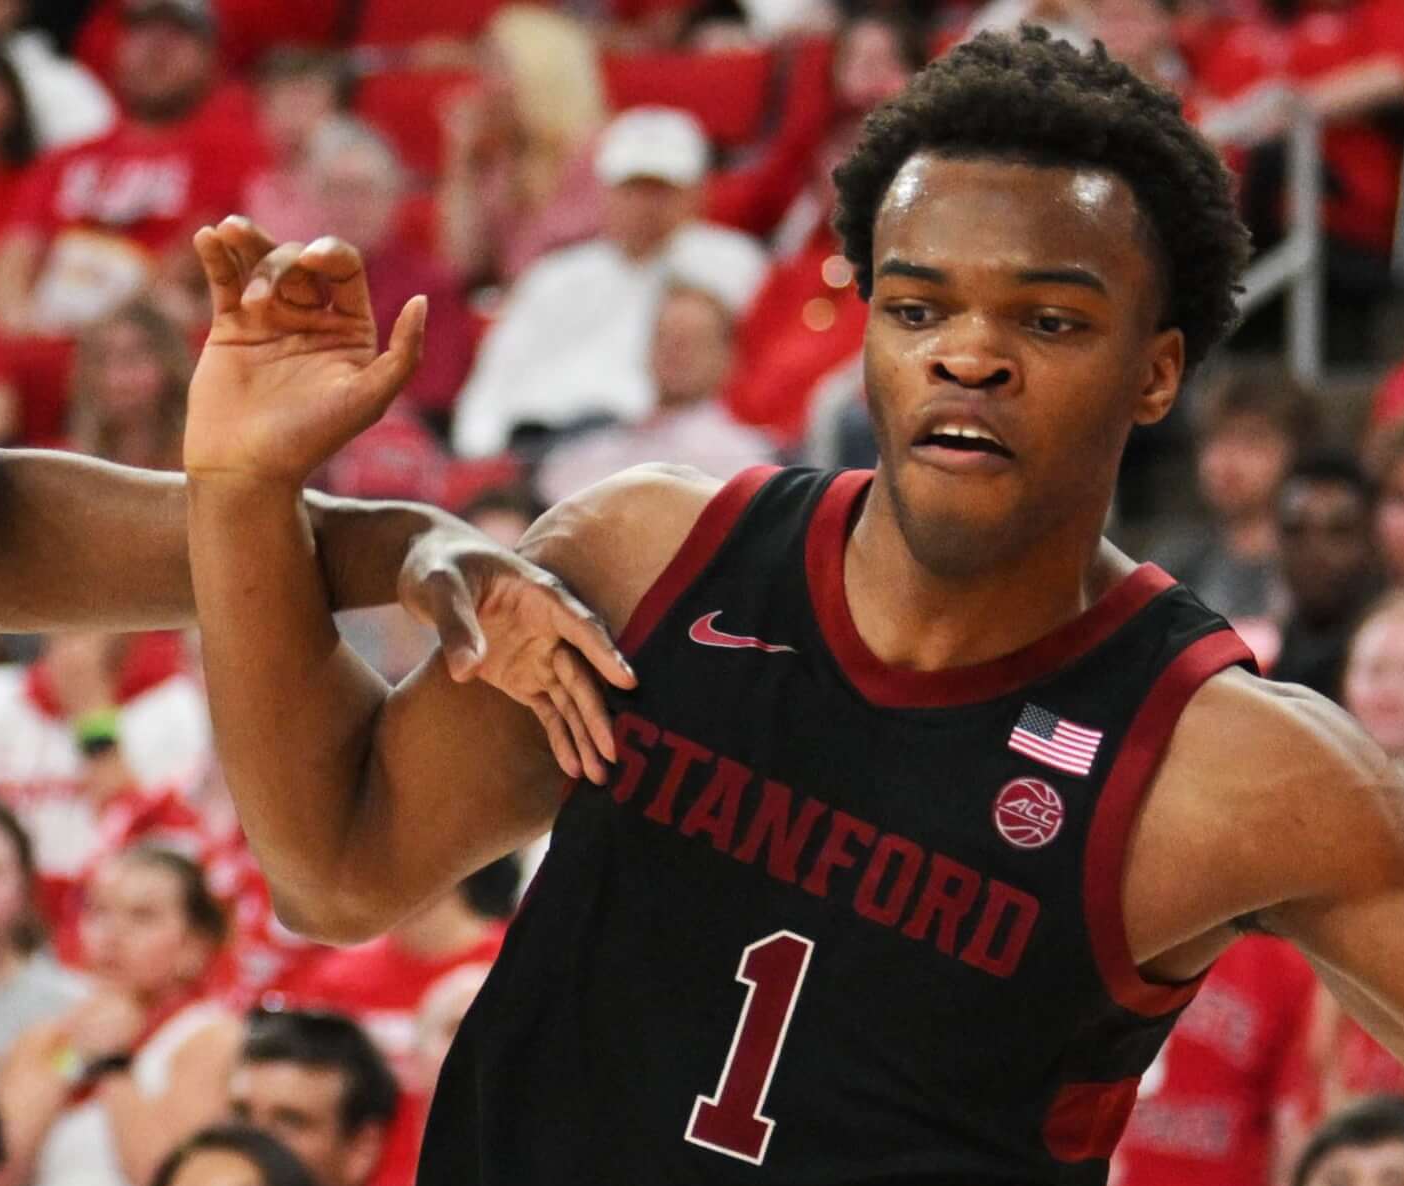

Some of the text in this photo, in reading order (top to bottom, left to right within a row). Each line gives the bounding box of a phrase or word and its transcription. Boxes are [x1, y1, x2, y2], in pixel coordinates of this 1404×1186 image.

[611, 711, 1041, 979] STANFORD
[1005, 798, 1062, 826] ACC
[684, 929, 816, 1166] 1
